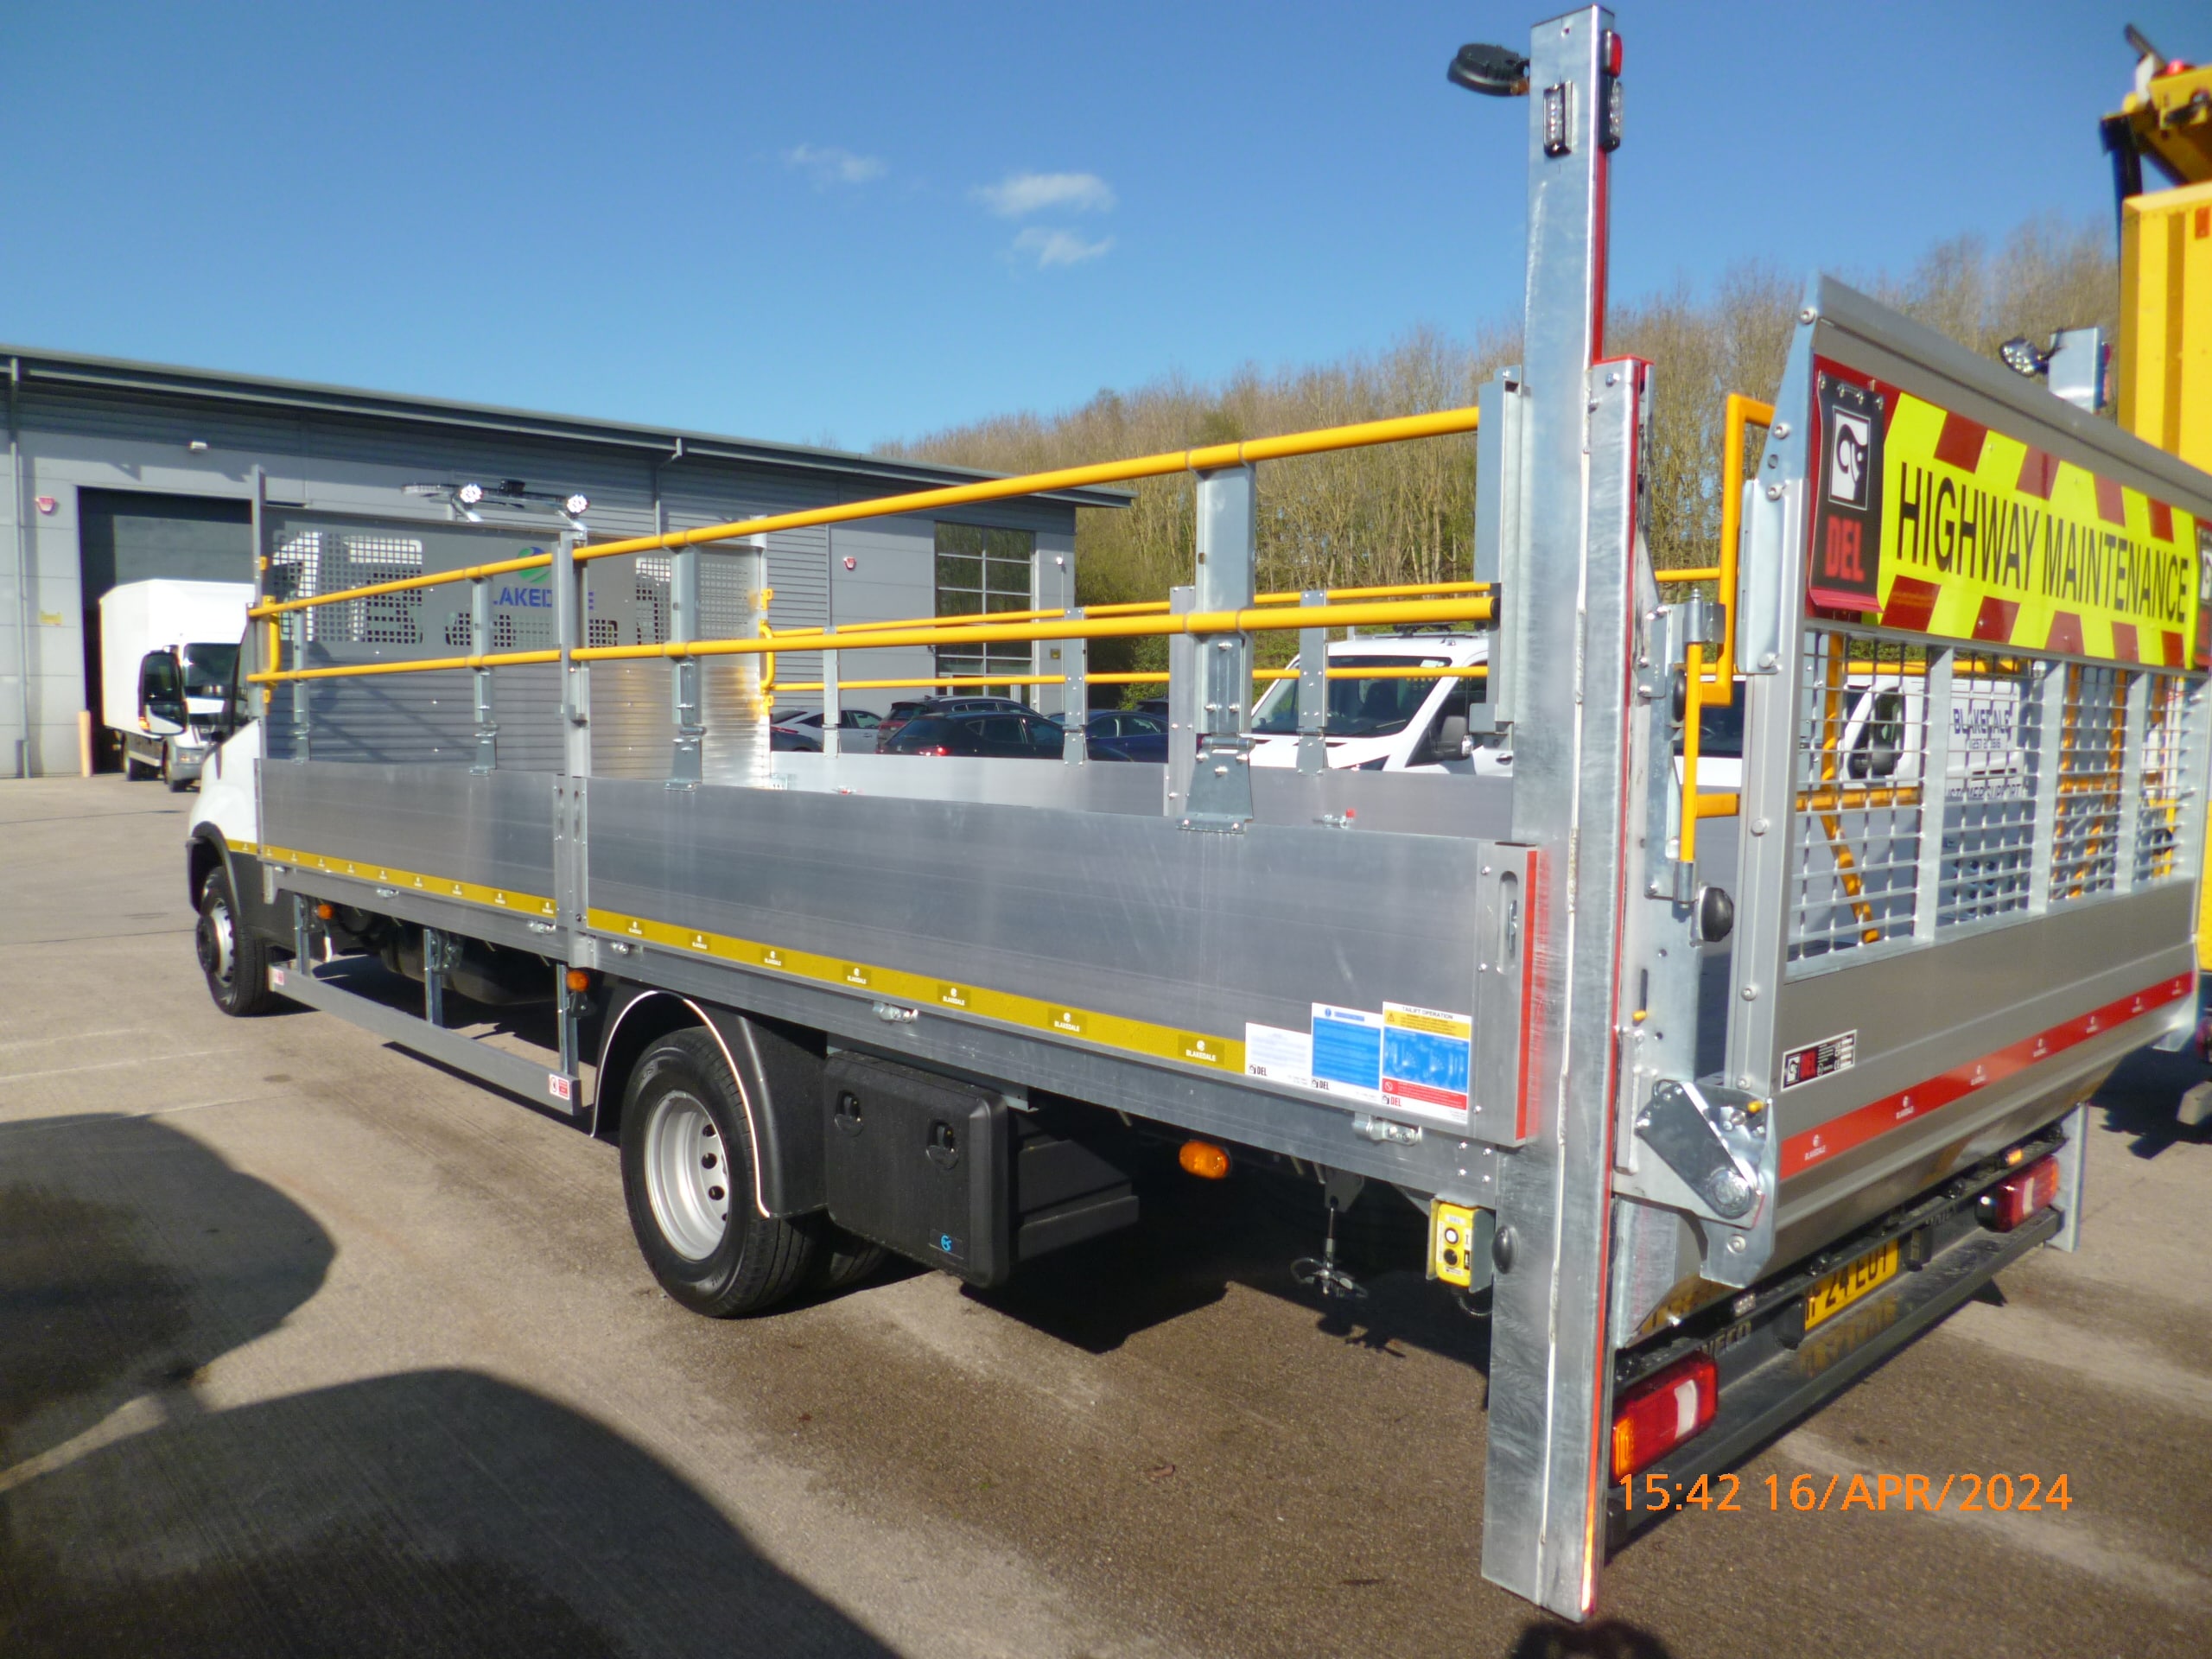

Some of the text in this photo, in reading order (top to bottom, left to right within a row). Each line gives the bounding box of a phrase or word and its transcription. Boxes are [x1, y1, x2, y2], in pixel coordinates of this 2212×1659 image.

[1896, 461, 2190, 624] HIGHWAY MAINTENANCE
[1824, 515, 1866, 583] DEL
[1185, 1049, 1217, 1062] BLAKEDALE
[1256, 1065, 1268, 1077] DEL
[1319, 1080, 1330, 1090] DEL
[1390, 1097, 1402, 1107] DEL
